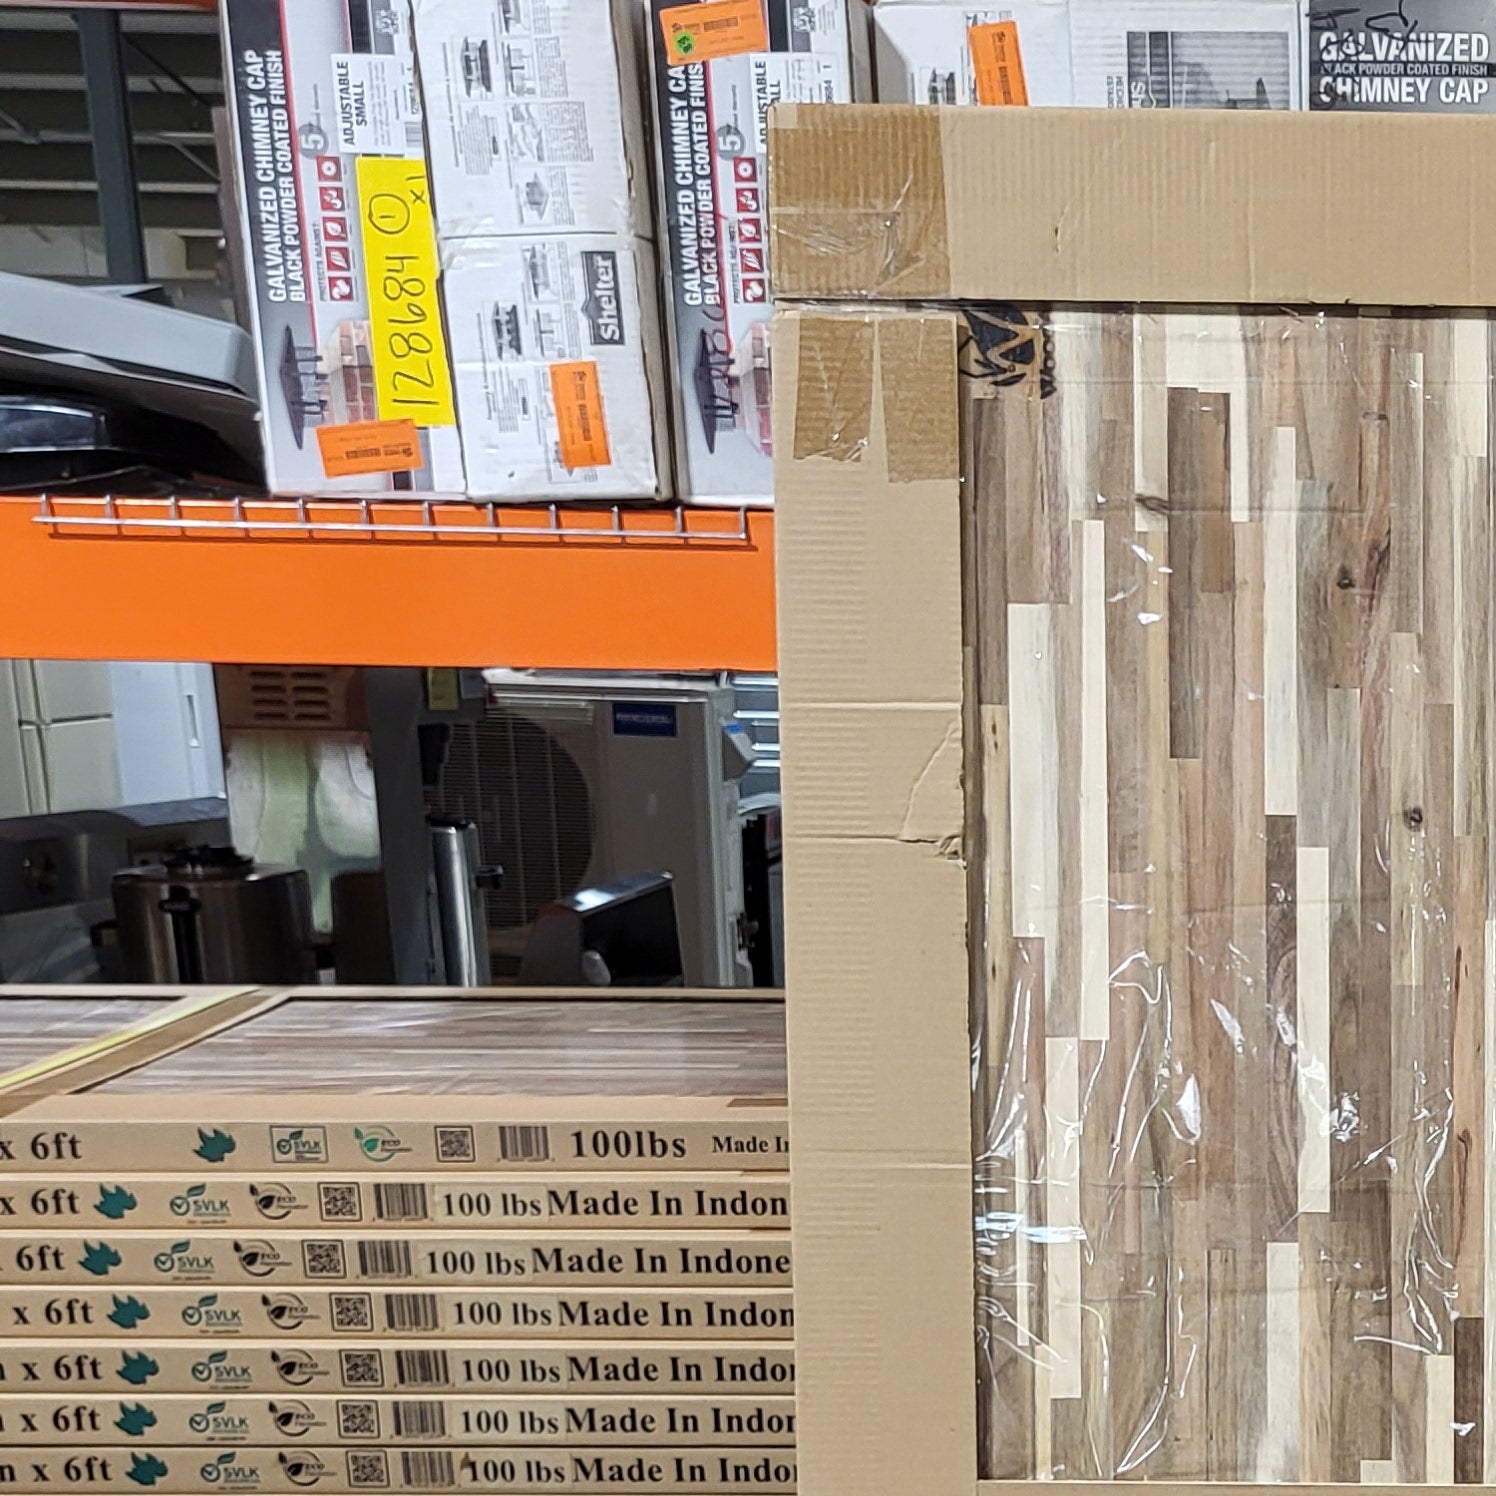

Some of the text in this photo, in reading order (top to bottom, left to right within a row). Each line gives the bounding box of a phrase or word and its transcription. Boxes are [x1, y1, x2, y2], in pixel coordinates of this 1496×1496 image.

[1319, 32, 1489, 62] GALVANIZED
[1359, 63, 1404, 76] POWDER
[1407, 64, 1449, 76] COATED
[1452, 64, 1487, 76] FINISH
[337, 61, 356, 146] ADJUSTABLE
[353, 81, 368, 127] SMALL
[1319, 76, 1488, 104] CHIMNEY CAP
[301, 131, 325, 151] 5
[244, 50, 286, 302] GALVANIZED CHIMNEY CAP
[266, 50, 305, 301] BLACK POWDER COATED FINISH
[667, 62, 702, 306] GALVANIZED CHIMNEY CA
[687, 61, 721, 306] BLACK POWDER COATED FINIS
[599, 255, 621, 342] Shelter
[30, 1132, 81, 1160] 6ft
[572, 1130, 686, 1158] 100lbs
[712, 1136, 769, 1153] Made
[0, 1196, 16, 1216] x
[30, 1188, 78, 1215] 6ft
[193, 1199, 230, 1212] SVLK
[445, 1193, 491, 1216] 100
[501, 1193, 542, 1216] lbs
[547, 1190, 638, 1216] Made
[650, 1190, 683, 1216] In
[15, 1244, 64, 1271] 6ft
[178, 1256, 214, 1269] SVLK
[428, 1251, 475, 1274] 100
[485, 1252, 526, 1275] lbs
[532, 1247, 623, 1274] Made
[635, 1248, 667, 1273] In
[12, 1306, 29, 1325] x
[44, 1298, 92, 1325] 6ft
[204, 1310, 242, 1322] SVLK
[455, 1302, 502, 1324] 100
[512, 1302, 552, 1325] lbs
[558, 1301, 649, 1327] Made
[661, 1301, 693, 1327] In
[21, 1362, 39, 1381] x
[53, 1354, 102, 1381] 6ft
[215, 1365, 252, 1378] SVLK
[464, 1359, 510, 1382] 100
[520, 1359, 561, 1382] lbs
[568, 1356, 658, 1382] Made
[670, 1356, 702, 1382] In
[21, 1413, 37, 1433] x
[52, 1405, 99, 1432] 6ft
[213, 1416, 249, 1429] SVLK
[462, 1410, 509, 1433] 100
[519, 1411, 559, 1434] lbs
[565, 1407, 655, 1433] Made
[667, 1407, 699, 1433] In
[31, 1456, 798, 1483] x 6ft SVLK 100 lbs Made In Indo
